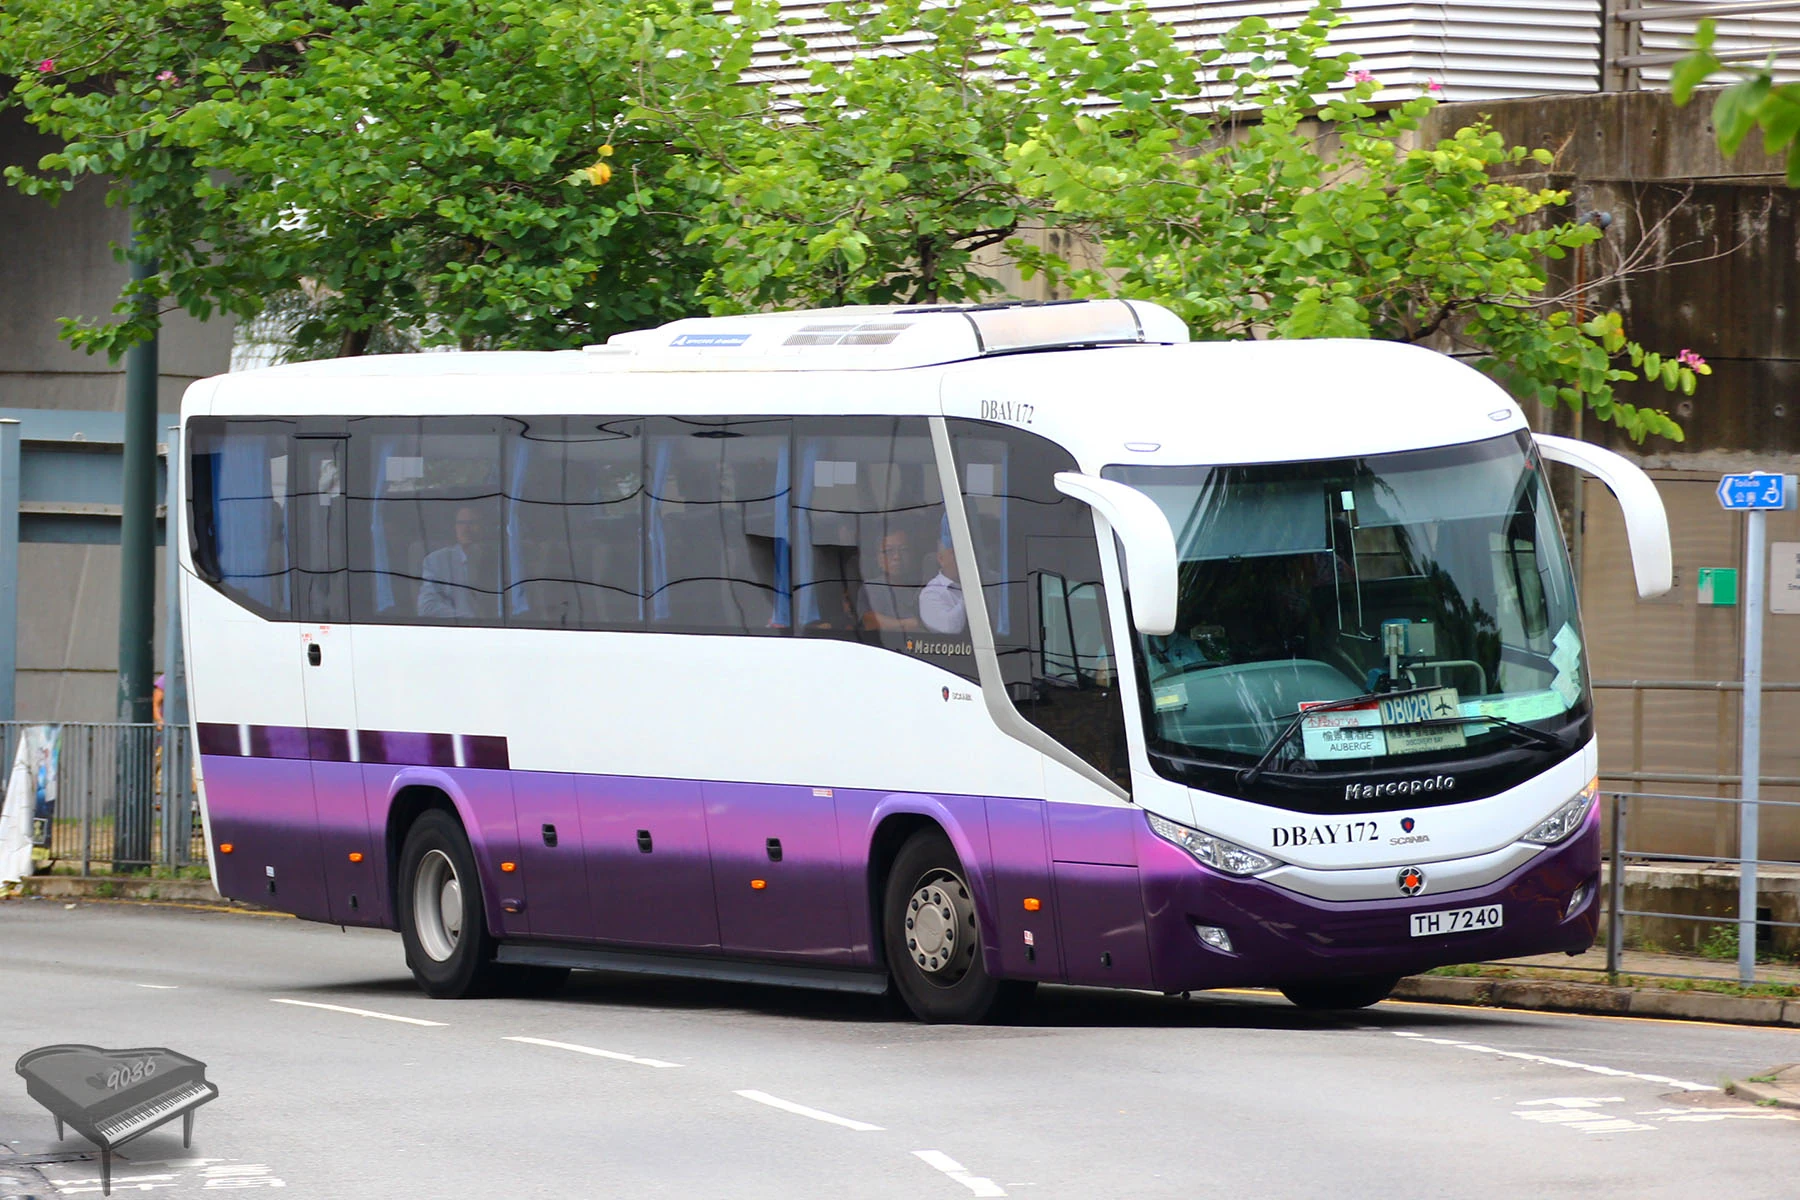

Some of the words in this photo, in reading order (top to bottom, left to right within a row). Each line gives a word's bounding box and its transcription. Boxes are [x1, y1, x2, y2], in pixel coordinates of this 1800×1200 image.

[914, 640, 972, 656] Marcopolo
[1383, 692, 1432, 725] DB02R
[1330, 741, 1372, 752] AUBERGE
[1345, 775, 1456, 800] Marcopolo
[1390, 834, 1430, 846] SCANIA
[1414, 914, 1440, 933] TH
[1449, 908, 1499, 930] 7240
